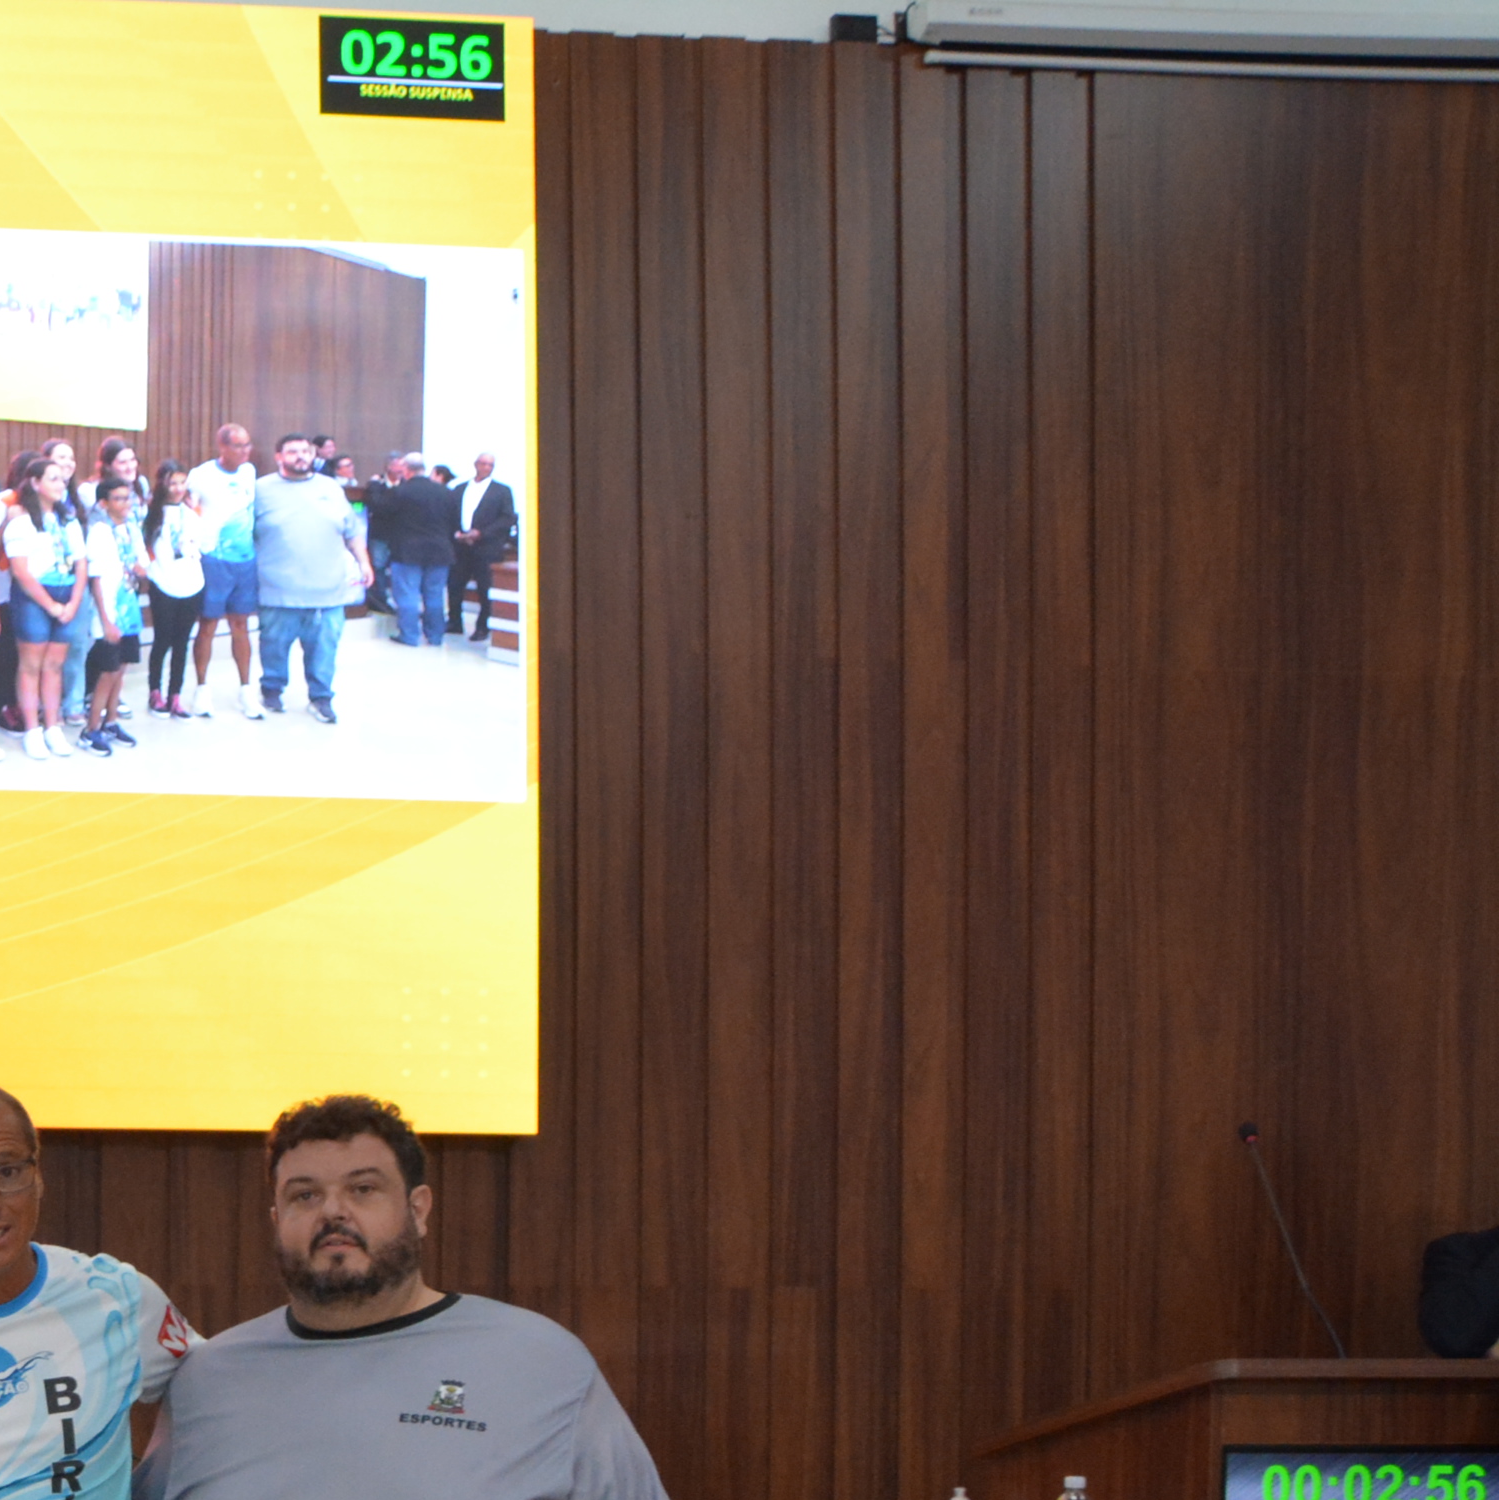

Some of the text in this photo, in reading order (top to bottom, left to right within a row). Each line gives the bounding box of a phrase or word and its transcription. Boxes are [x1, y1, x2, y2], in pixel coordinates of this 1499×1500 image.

[340, 29, 493, 80] 02:56
[359, 83, 473, 102] SESSÃO SUSPENSA
[399, 1413, 487, 1432] ESPORTES
